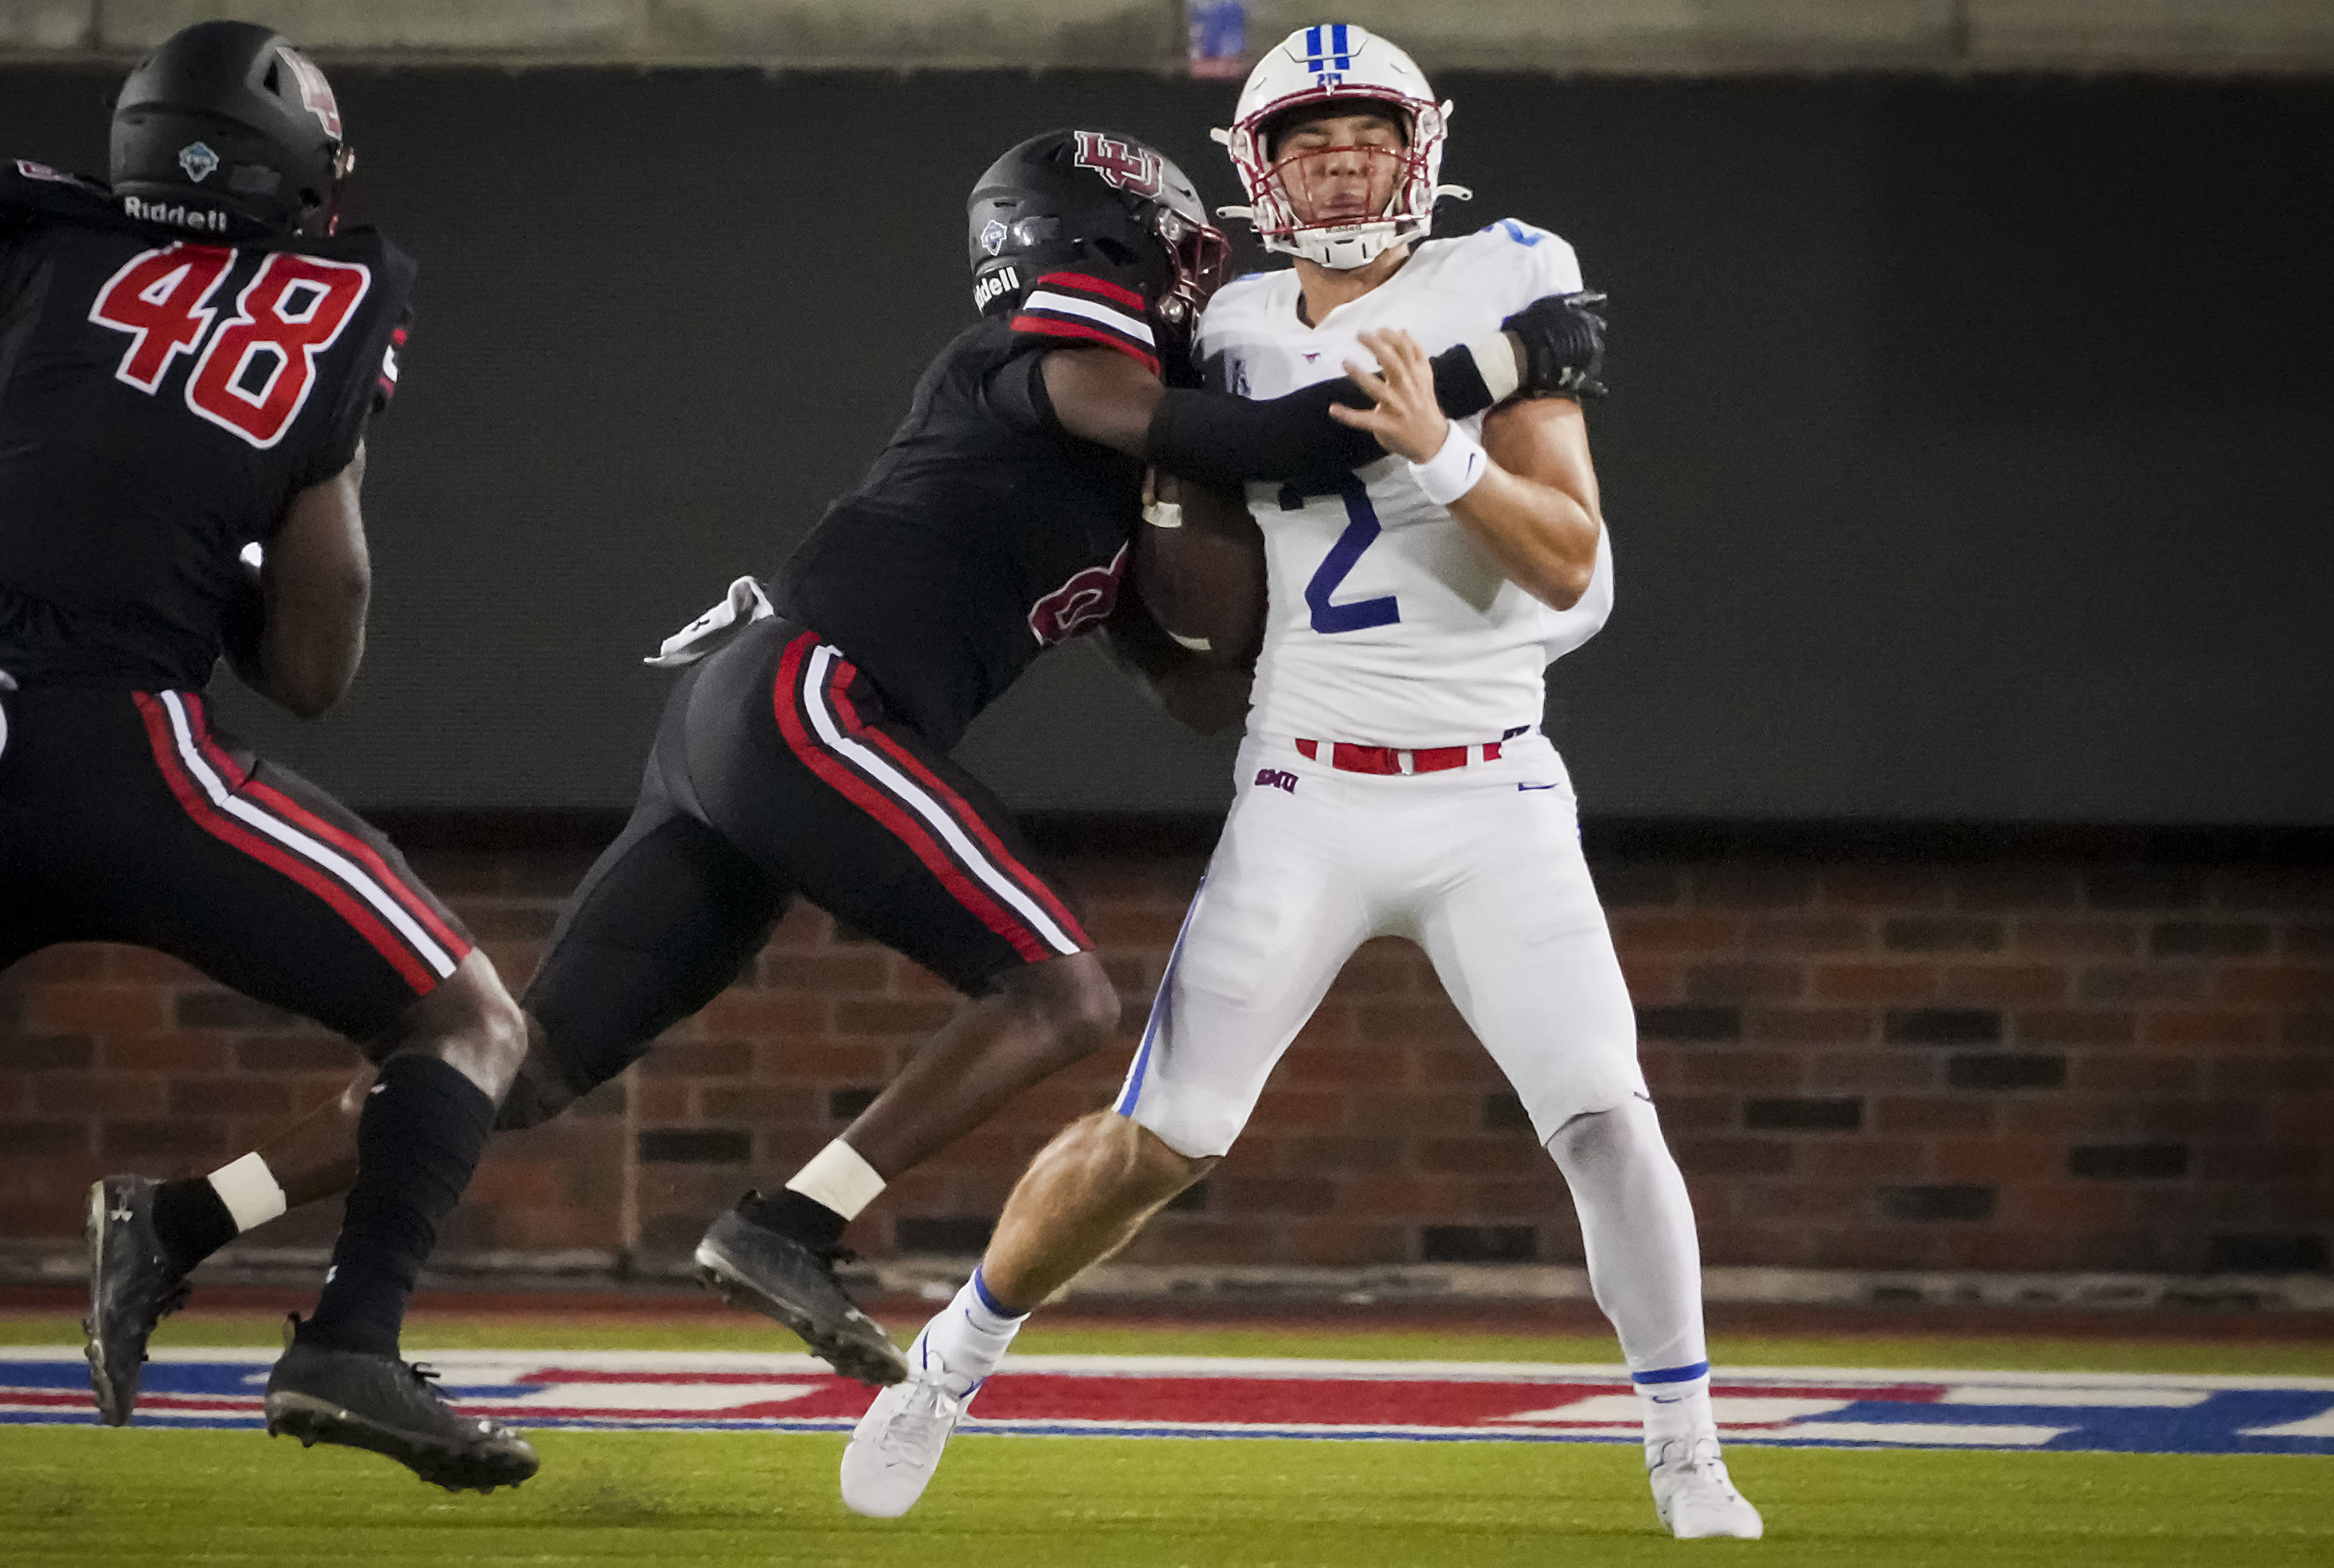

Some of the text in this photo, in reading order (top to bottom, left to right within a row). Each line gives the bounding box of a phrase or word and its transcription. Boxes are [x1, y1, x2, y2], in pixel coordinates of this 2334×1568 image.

[125, 196, 226, 232] Riddell
[88, 241, 371, 450] 48
[1278, 469, 1400, 633] 2
